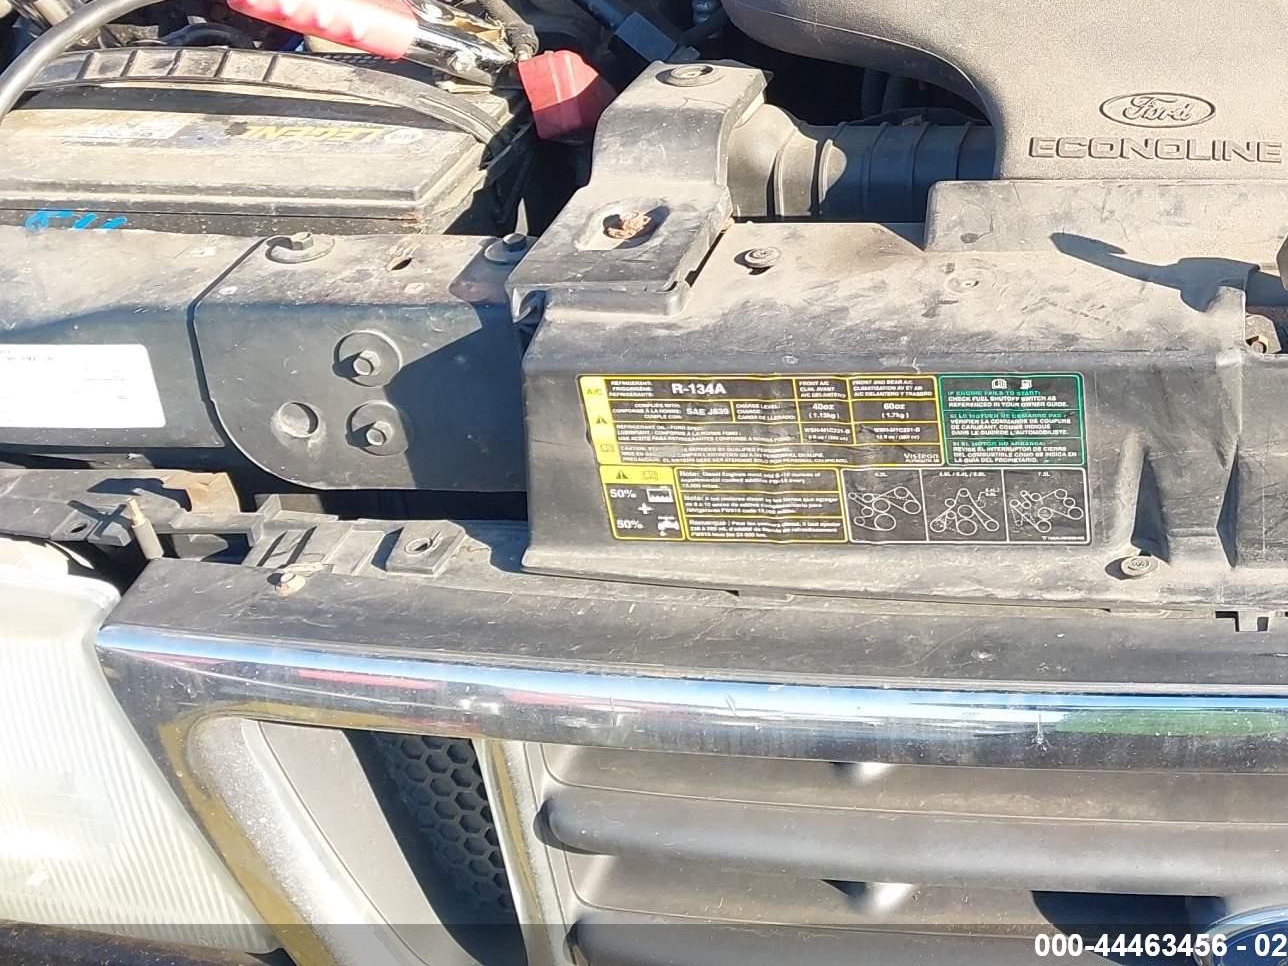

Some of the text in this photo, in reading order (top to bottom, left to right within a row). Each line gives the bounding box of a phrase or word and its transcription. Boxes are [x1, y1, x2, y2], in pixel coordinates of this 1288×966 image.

[1123, 96, 1193, 122] Ford
[1028, 137, 1282, 163] ECONOLINE
[671, 383, 727, 395] R-134A
[610, 488, 637, 498] 50%
[616, 520, 644, 529] 50%
